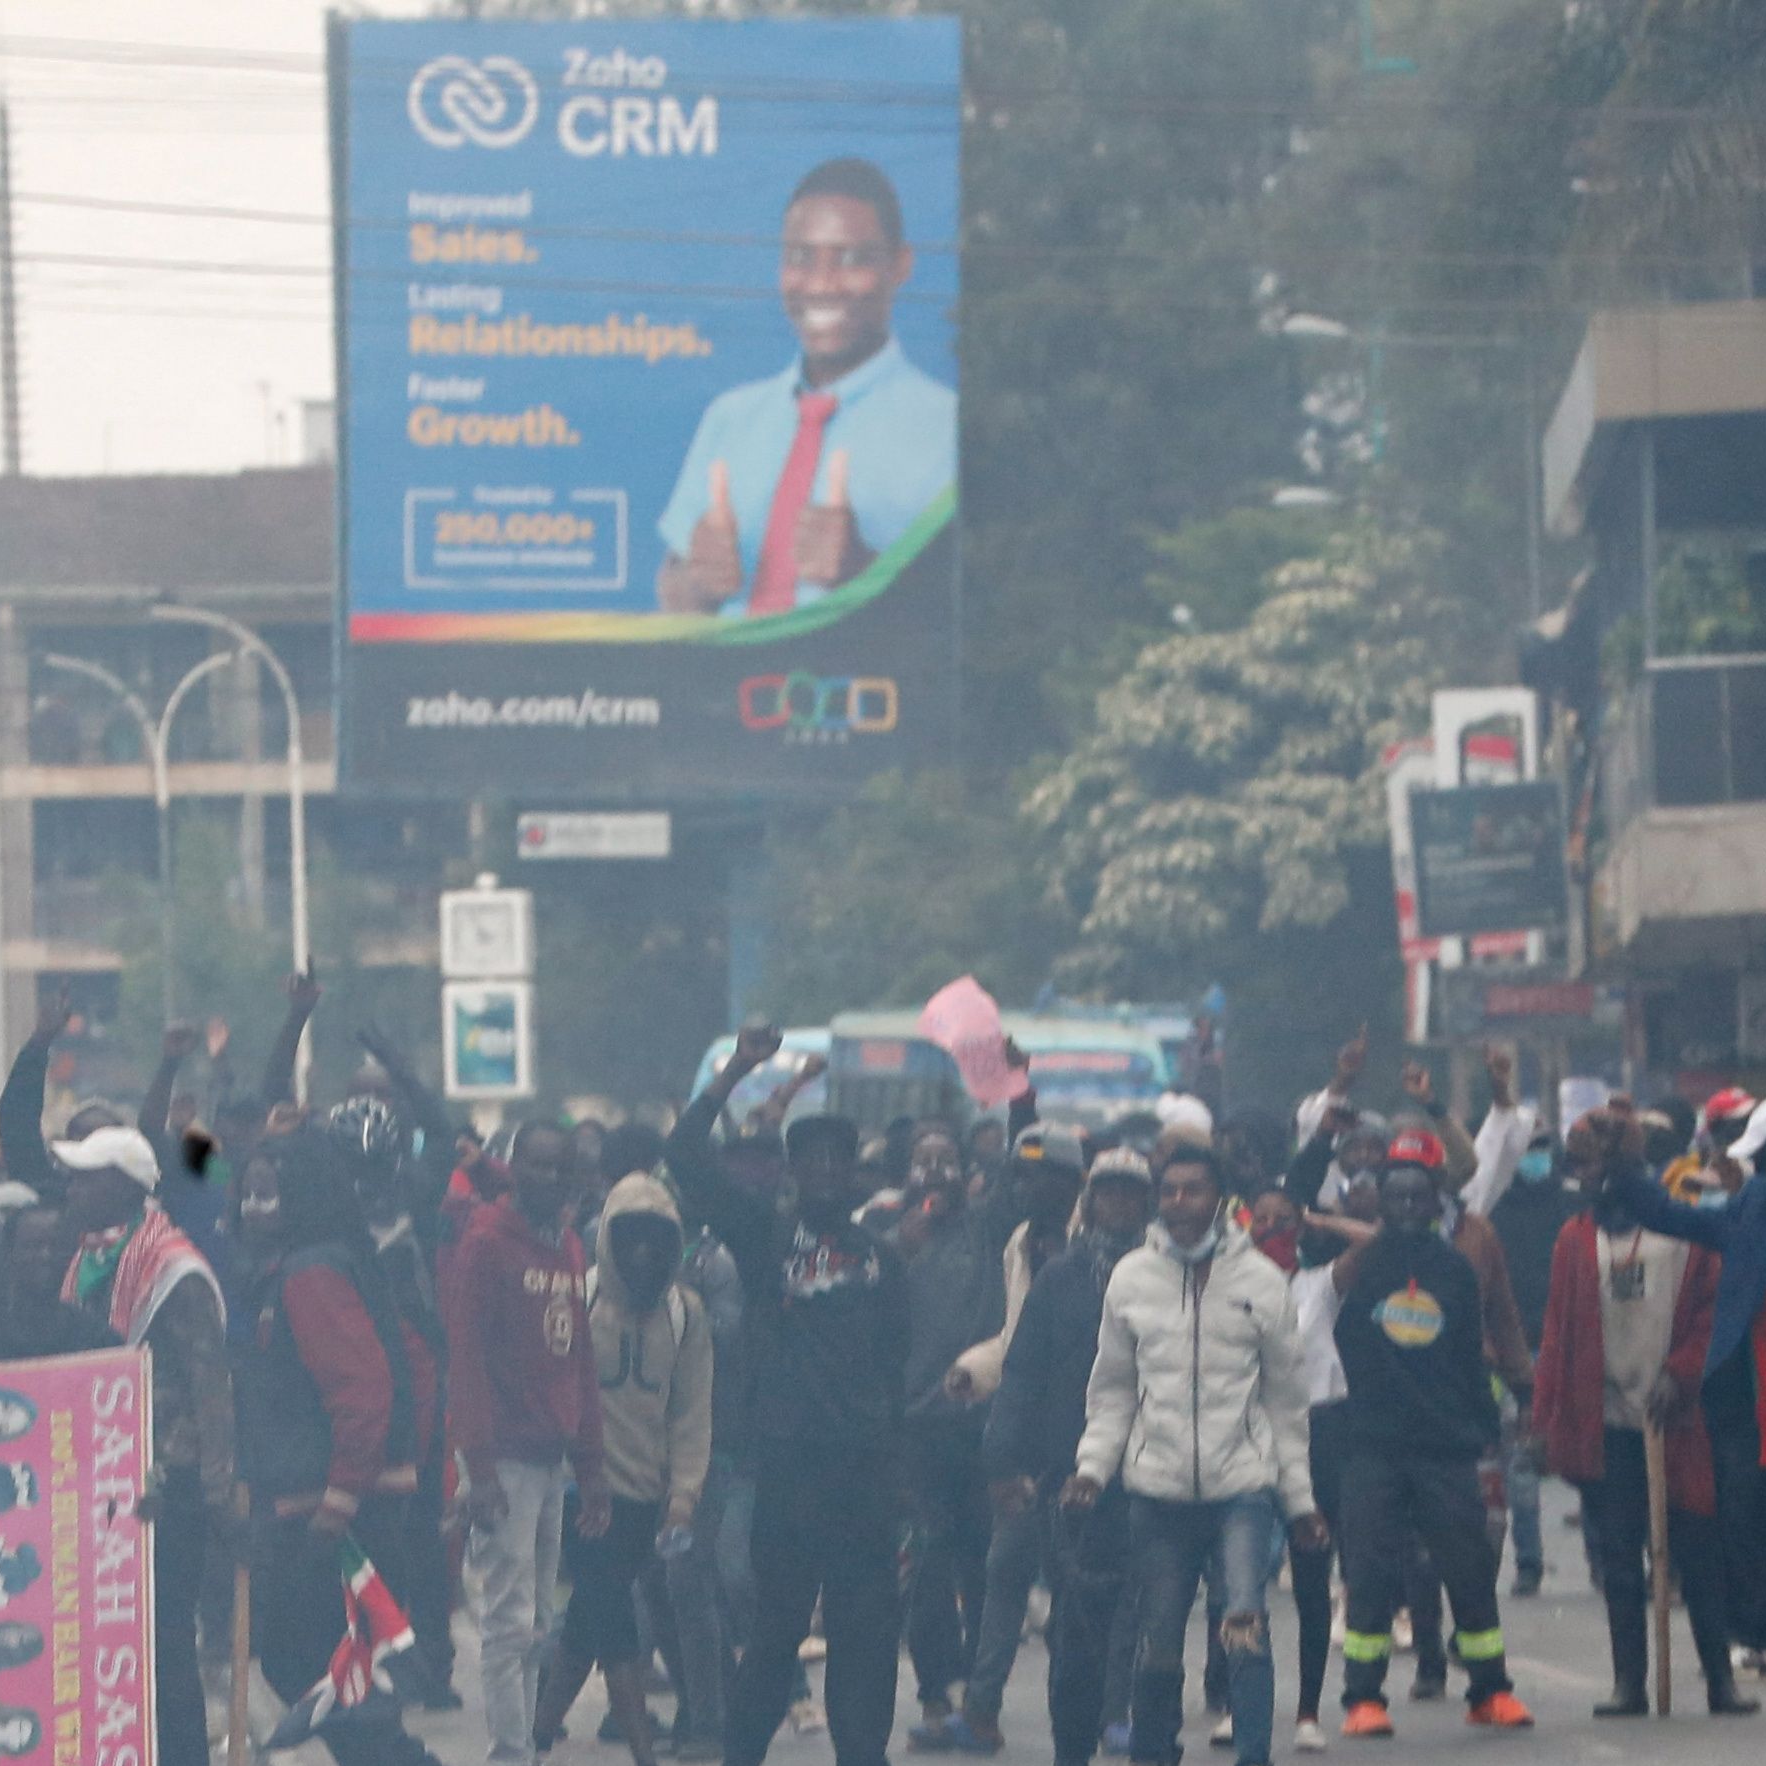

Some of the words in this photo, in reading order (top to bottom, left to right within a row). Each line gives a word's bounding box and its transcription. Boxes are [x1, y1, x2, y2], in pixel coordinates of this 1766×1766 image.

[562, 47, 668, 90] Zoho
[556, 94, 720, 156] CRM
[409, 222, 539, 264] Sales.
[409, 312, 712, 365] Relationships.
[408, 403, 581, 447] Growth.
[407, 689, 661, 729] zoho.com/crm
[91, 1374, 136, 1631] SARAH
[51, 1489, 80, 1614] HUMAN
